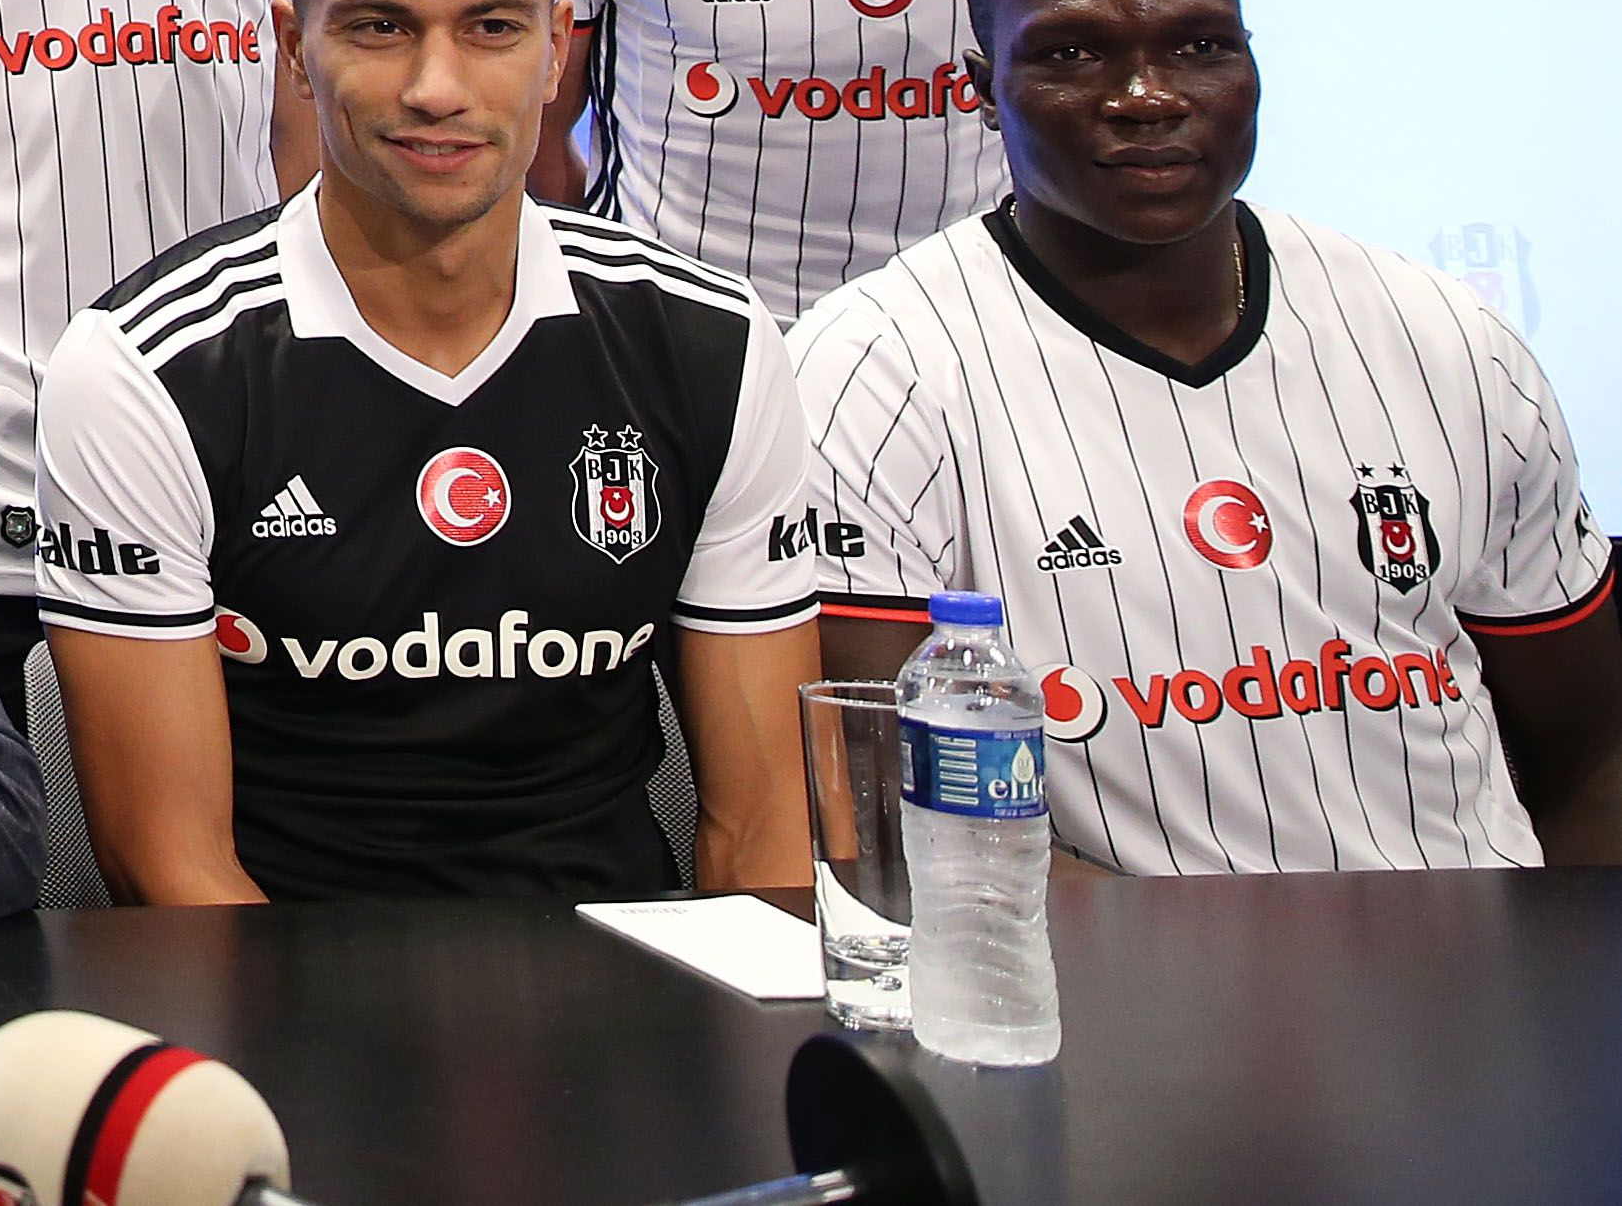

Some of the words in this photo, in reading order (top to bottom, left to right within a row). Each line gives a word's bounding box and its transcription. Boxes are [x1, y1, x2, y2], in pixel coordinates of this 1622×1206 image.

[746, 61, 982, 121] vodafo
[587, 458, 643, 482] BJK
[1362, 492, 1421, 515] BJK
[251, 514, 337, 538] adidas
[595, 529, 643, 545] 1903
[1036, 548, 1122, 571] adidas
[1379, 563, 1427, 579] 1903
[280, 609, 655, 681] vodafone
[1111, 638, 1462, 729] vodafone
